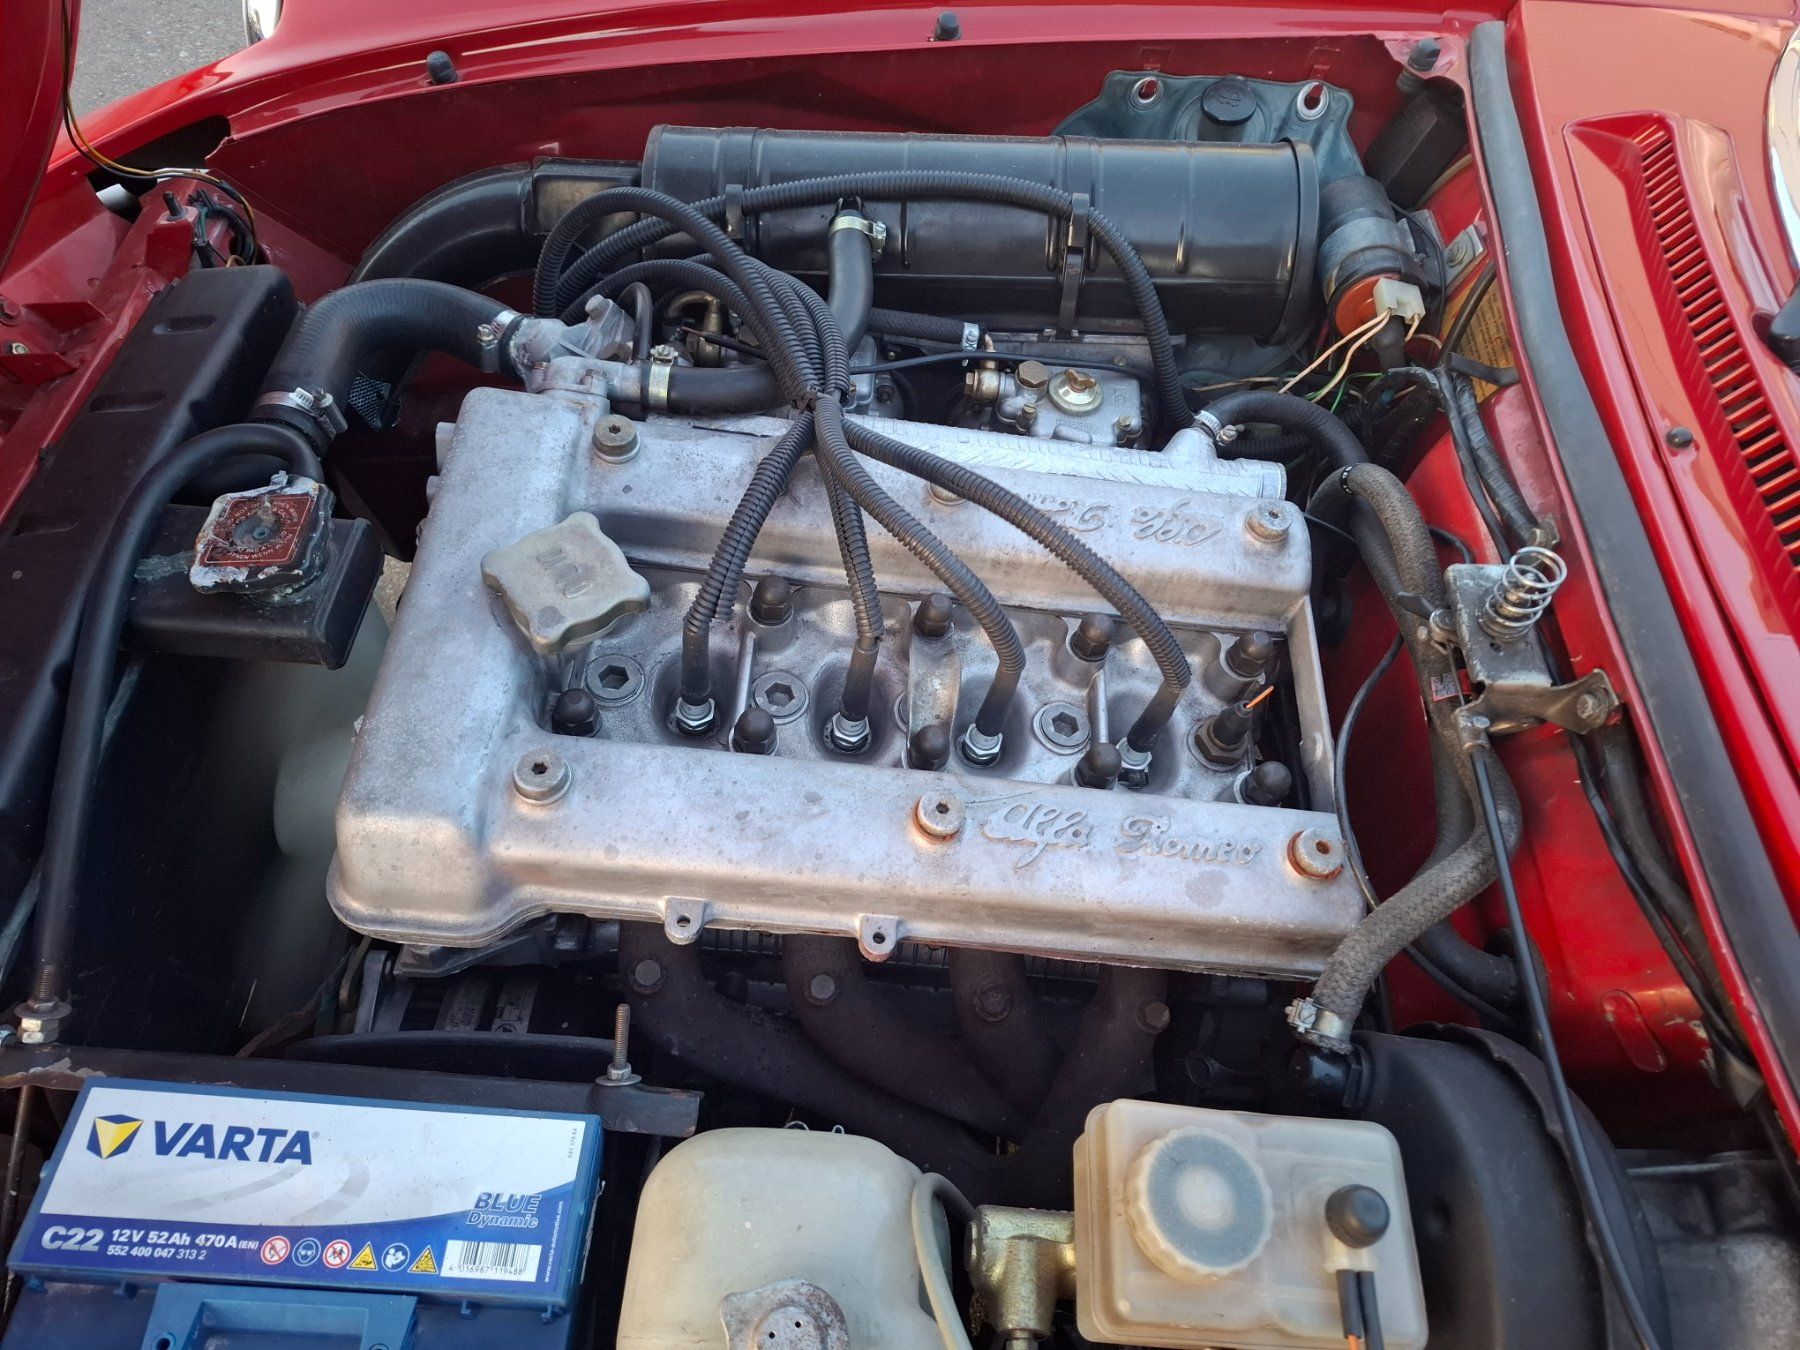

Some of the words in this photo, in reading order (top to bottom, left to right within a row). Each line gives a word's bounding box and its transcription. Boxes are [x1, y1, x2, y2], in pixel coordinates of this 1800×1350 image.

[978, 804, 1094, 871] Alfa
[1116, 815, 1263, 865] Romeo
[154, 1120, 313, 1165] VARTA
[473, 1191, 543, 1214] BLUE
[466, 1210, 540, 1229] Dynamic
[41, 1225, 104, 1252] C22
[112, 1229, 145, 1243] 12V
[147, 1231, 191, 1246] 52Ah
[106, 1245, 128, 1256] 552
[130, 1246, 151, 1257] 400
[153, 1248, 175, 1258] 047
[176, 1249, 197, 1260] 313
[198, 1250, 207, 1260] 2
